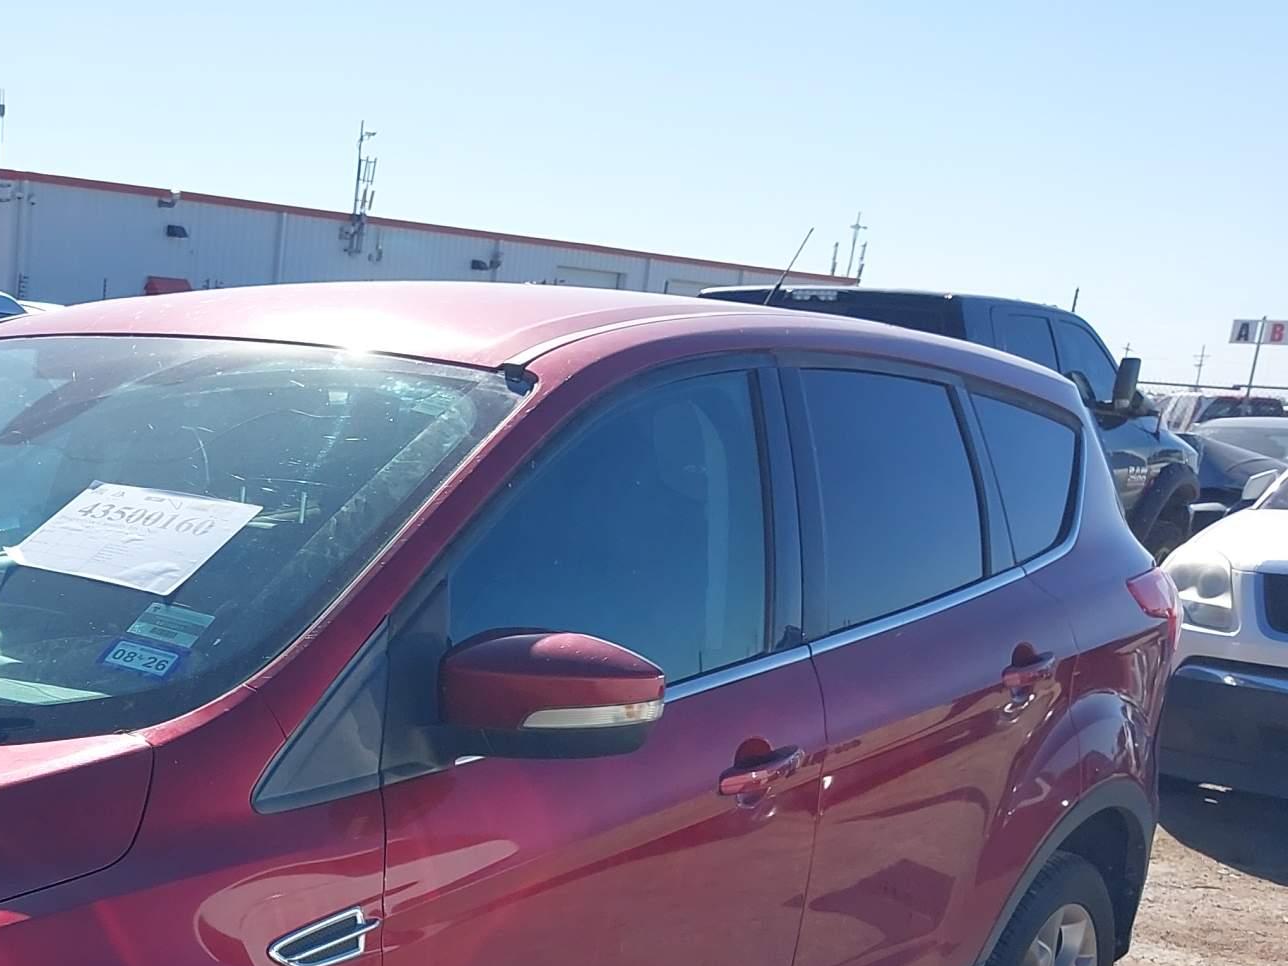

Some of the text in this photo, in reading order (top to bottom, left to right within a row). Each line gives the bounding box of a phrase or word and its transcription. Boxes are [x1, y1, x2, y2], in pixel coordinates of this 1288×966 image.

[1236, 322, 1250, 341] A
[1271, 323, 1285, 342] B
[78, 502, 215, 536] 43500160
[112, 648, 169, 672] 08 26
